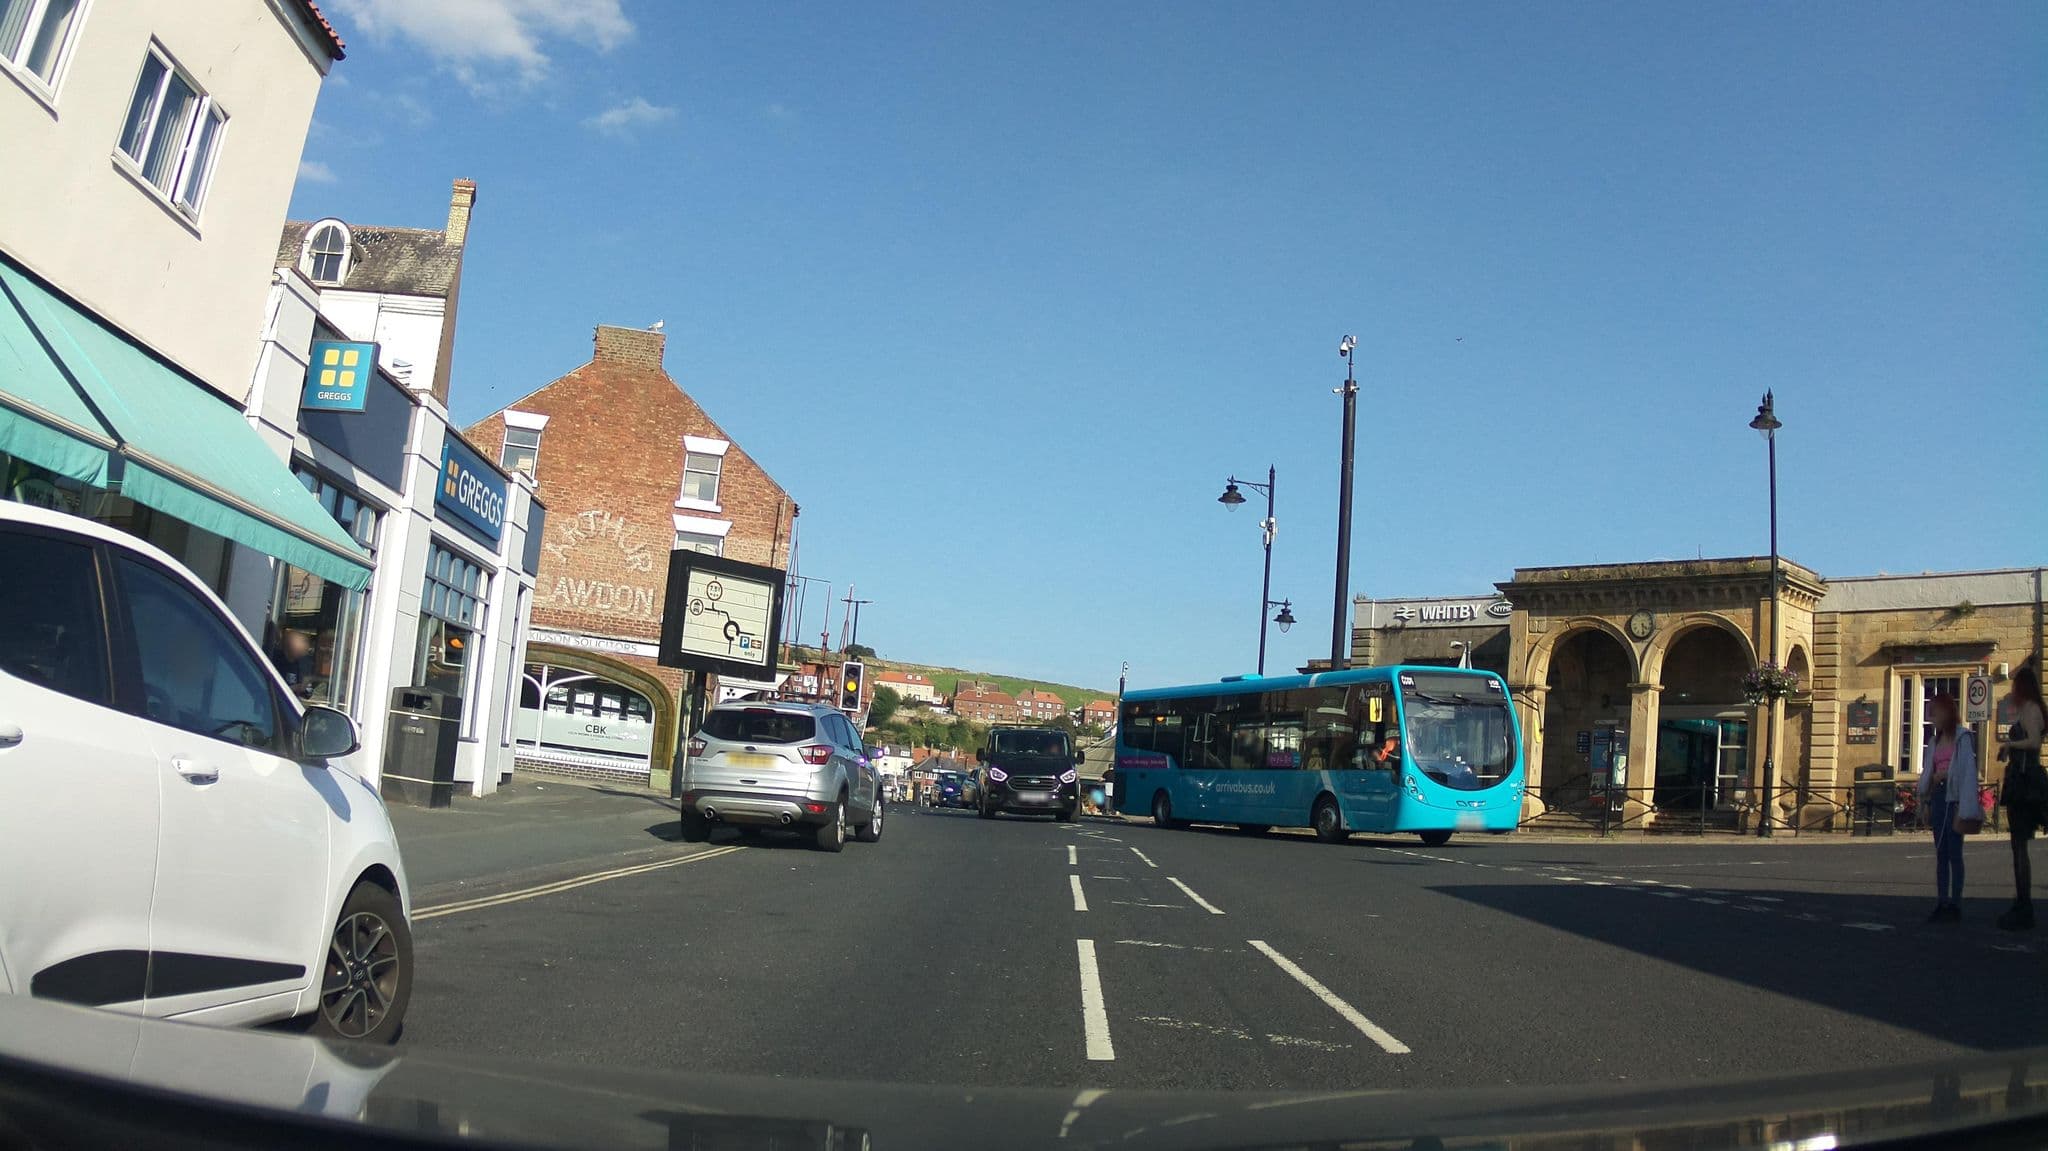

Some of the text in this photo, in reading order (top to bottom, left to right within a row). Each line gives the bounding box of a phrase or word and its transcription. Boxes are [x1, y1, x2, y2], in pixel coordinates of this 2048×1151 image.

[317, 391, 352, 401] GREGGS
[458, 469, 503, 528] GREGGS
[1421, 603, 1482, 620] WHITBY
[575, 637, 638, 653] SOLICITORS
[741, 637, 749, 647] P
[1971, 686, 1984, 697] 20
[1968, 710, 1985, 719] ZONE
[585, 724, 607, 735] CBK
[1215, 779, 1276, 794] arrivabus.co.uk
